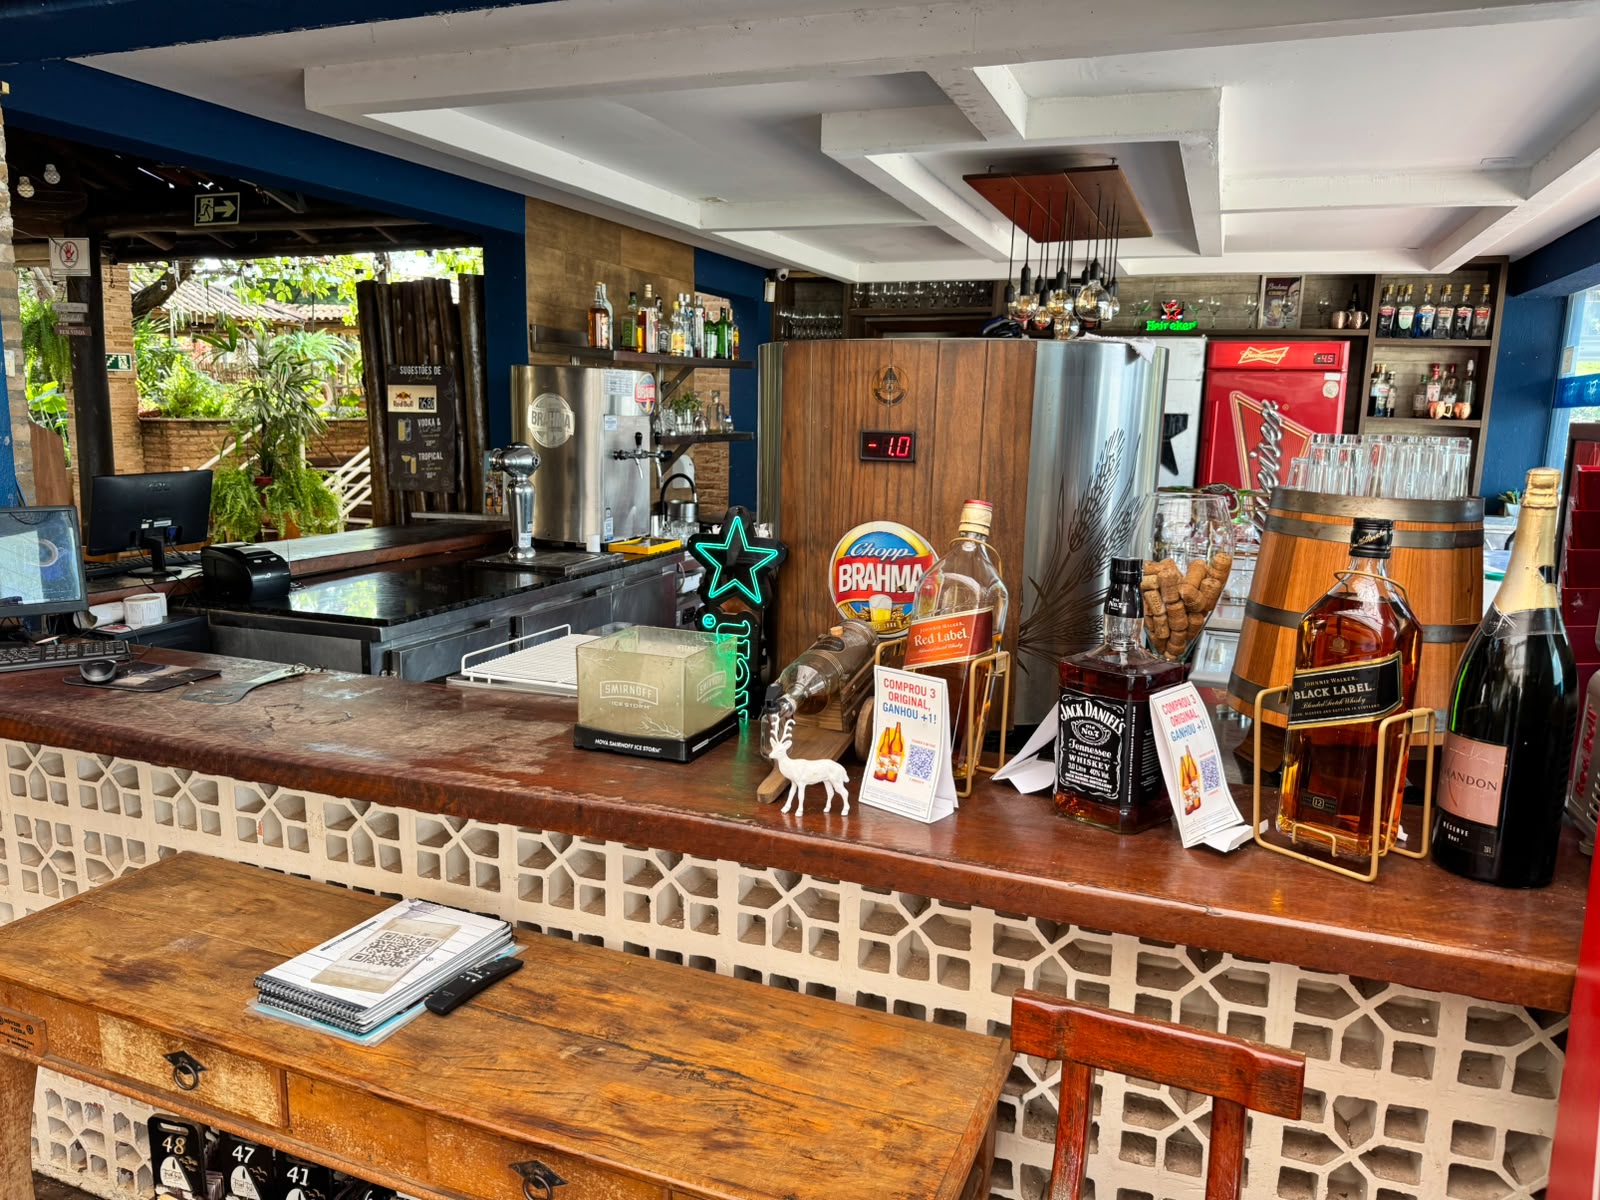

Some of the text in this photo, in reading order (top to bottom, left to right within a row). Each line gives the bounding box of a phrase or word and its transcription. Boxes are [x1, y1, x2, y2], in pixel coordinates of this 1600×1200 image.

[400, 365, 442, 375] SUGESTÕES DE
[417, 418, 436, 427] VODKA
[531, 410, 571, 428] BRAHMA
[418, 452, 443, 460] TROPICAL
[851, 542, 916, 561] Chopp
[839, 563, 923, 593] BRAHMA
[913, 633, 934, 646] Red
[605, 683, 653, 699] SMIRNOFF
[884, 678, 936, 699] COMPROU 3
[1304, 680, 1330, 688] JOHNNIE
[888, 691, 931, 711] ORIGINAL,
[1294, 688, 1331, 700] BLACK
[882, 702, 937, 725] GANHOU +1!
[1060, 703, 1085, 721] JACK
[1161, 693, 1198, 716] COMPROU 3
[1081, 727, 1100, 737] No.7
[1170, 719, 1207, 742] GANHOU +1!
[1068, 738, 1112, 758] Tennessee
[1068, 753, 1111, 771] WHISKEY
[1314, 799, 1322, 807] 12
[162, 1136, 186, 1154] 48
[232, 1145, 255, 1163] 47
[286, 1166, 309, 1186] 41
